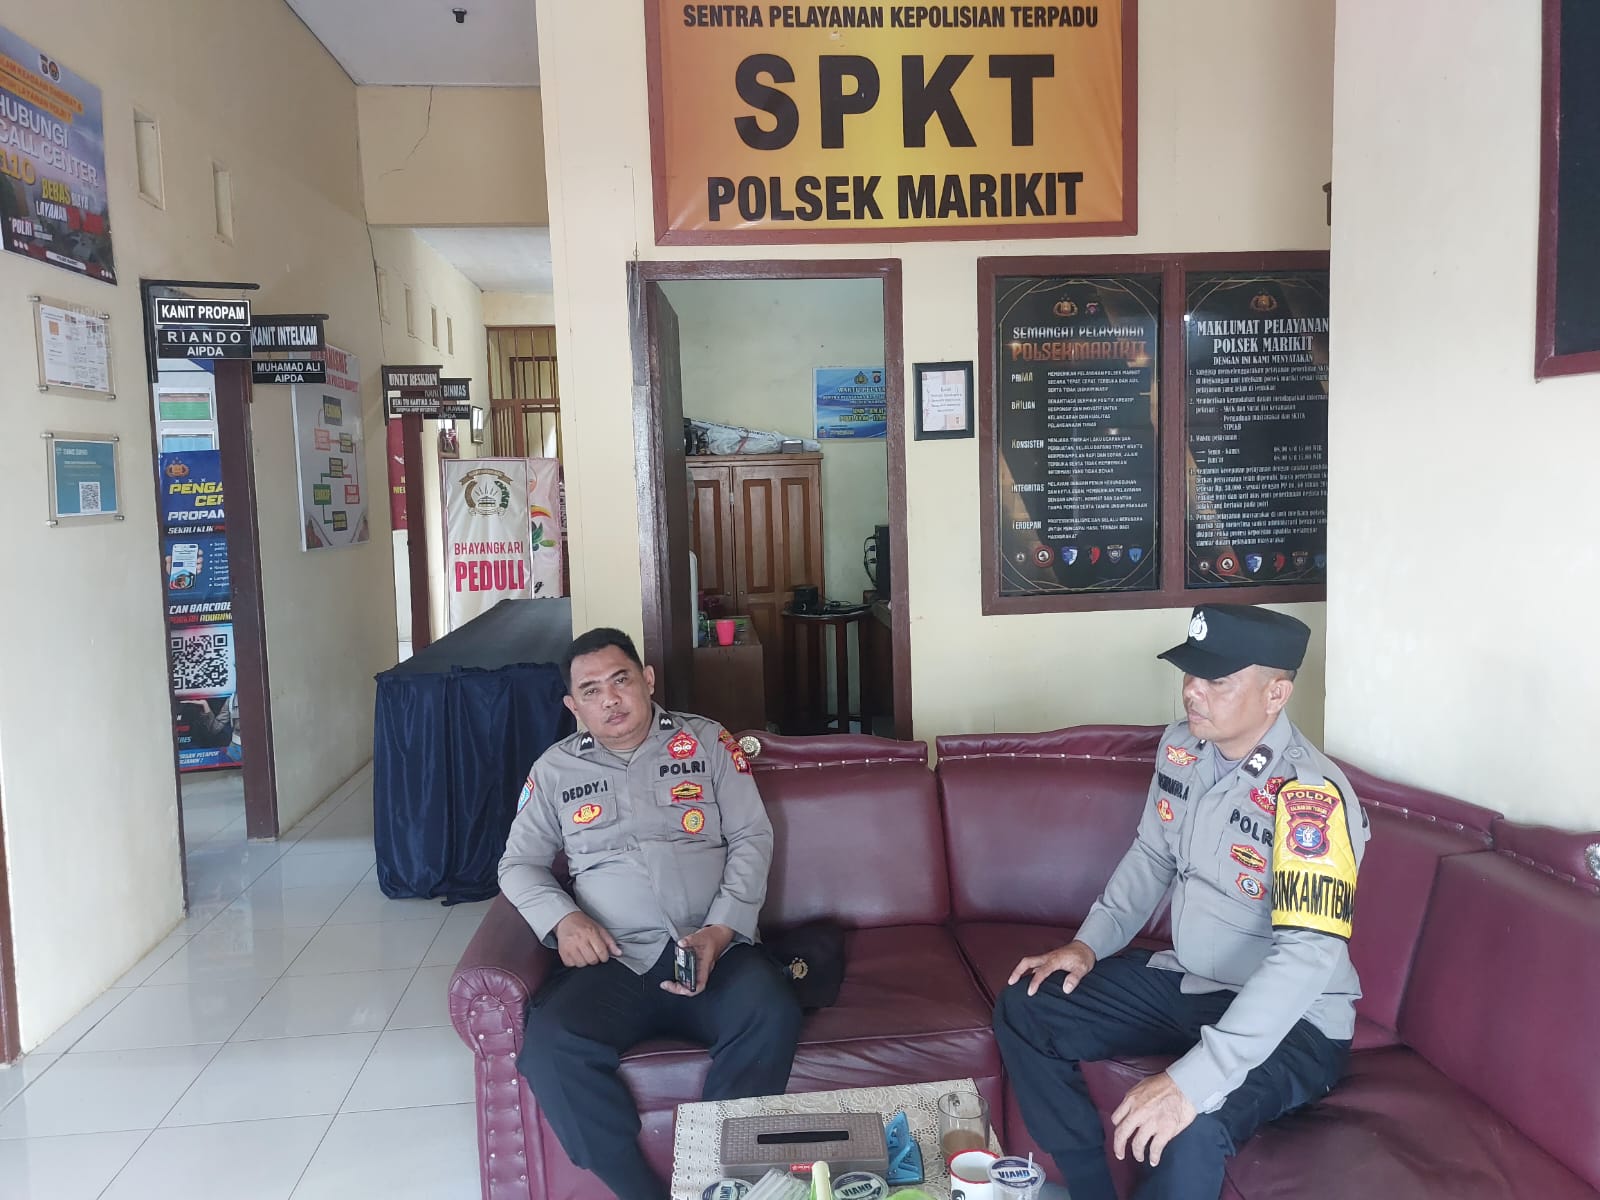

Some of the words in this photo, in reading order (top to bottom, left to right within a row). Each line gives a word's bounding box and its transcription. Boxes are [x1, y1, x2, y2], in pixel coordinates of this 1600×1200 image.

[684, 7, 763, 28] SENTRA
[769, 6, 883, 28] PELAYANAN
[890, 6, 1005, 28] KEPOLISIAN
[1011, 6, 1098, 28] TERPADU
[734, 53, 1055, 151] SPKT
[39, 143, 99, 186] CENTER
[42, 178, 72, 206] BEBAS
[707, 176, 884, 222] POLSEK
[898, 173, 1084, 220] MARIKIT
[36, 200, 67, 222] LAYANAN
[12, 218, 33, 237] POLRI
[161, 305, 195, 319] KANIT
[198, 305, 245, 320] PROPAM
[1013, 327, 1074, 339] SEMANGAT
[1079, 325, 1144, 338] PELAYANAN
[1197, 320, 1260, 336] MAKLUMAT
[1264, 318, 1329, 335] PELAYANAN
[167, 332, 241, 344] RIANDO
[252, 326, 275, 346] KANIT
[278, 325, 318, 346] INTELKAM
[187, 346, 224, 357] AIPDA
[1010, 342, 1072, 361] POLSEK
[1213, 337, 1259, 353] POLSEK
[1263, 336, 1314, 352] MARIKIT
[1213, 356, 1239, 365] DENGAN
[1241, 355, 1251, 364] INI
[1252, 354, 1270, 364] KAMI
[1271, 353, 1313, 363] MENYATAKAN
[256, 362, 304, 373] MUHAMAD
[305, 362, 321, 372] ALI
[274, 373, 304, 383] AIPDA
[389, 373, 409, 386] UNIT
[410, 373, 438, 386] RESKRIM
[444, 384, 467, 397] BINMAS
[1011, 440, 1044, 448] KONSISTEN
[1011, 484, 1045, 492] INTEGRITAS
[1012, 521, 1042, 529] TERDEPAN
[454, 541, 524, 556] BHAYANGKARI
[455, 559, 525, 592] PEDULI
[189, 601, 232, 613] BARCODE
[659, 760, 706, 777] POLRI
[1286, 790, 1333, 805] POLDA
[998, 1168, 1031, 1179] VIAND
[843, 1183, 873, 1197] VIAND
